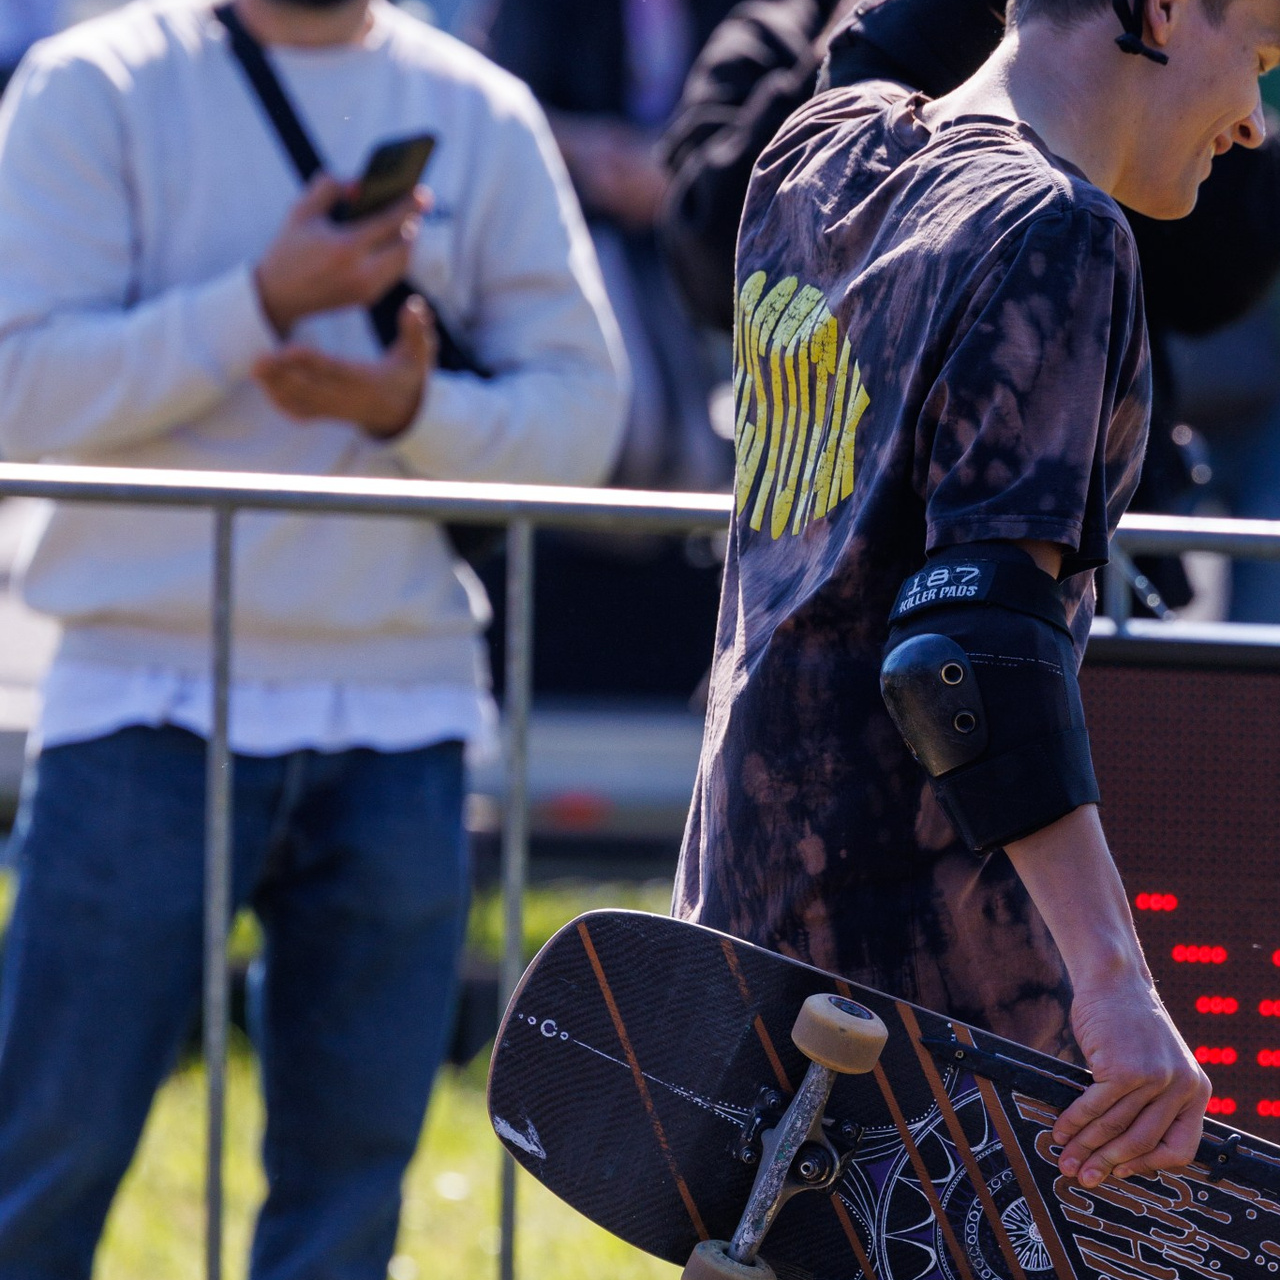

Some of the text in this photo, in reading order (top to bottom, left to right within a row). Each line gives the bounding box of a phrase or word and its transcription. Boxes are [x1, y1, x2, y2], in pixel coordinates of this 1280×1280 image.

[908, 567, 980, 596] 187
[899, 585, 979, 614] KILLER PADS
